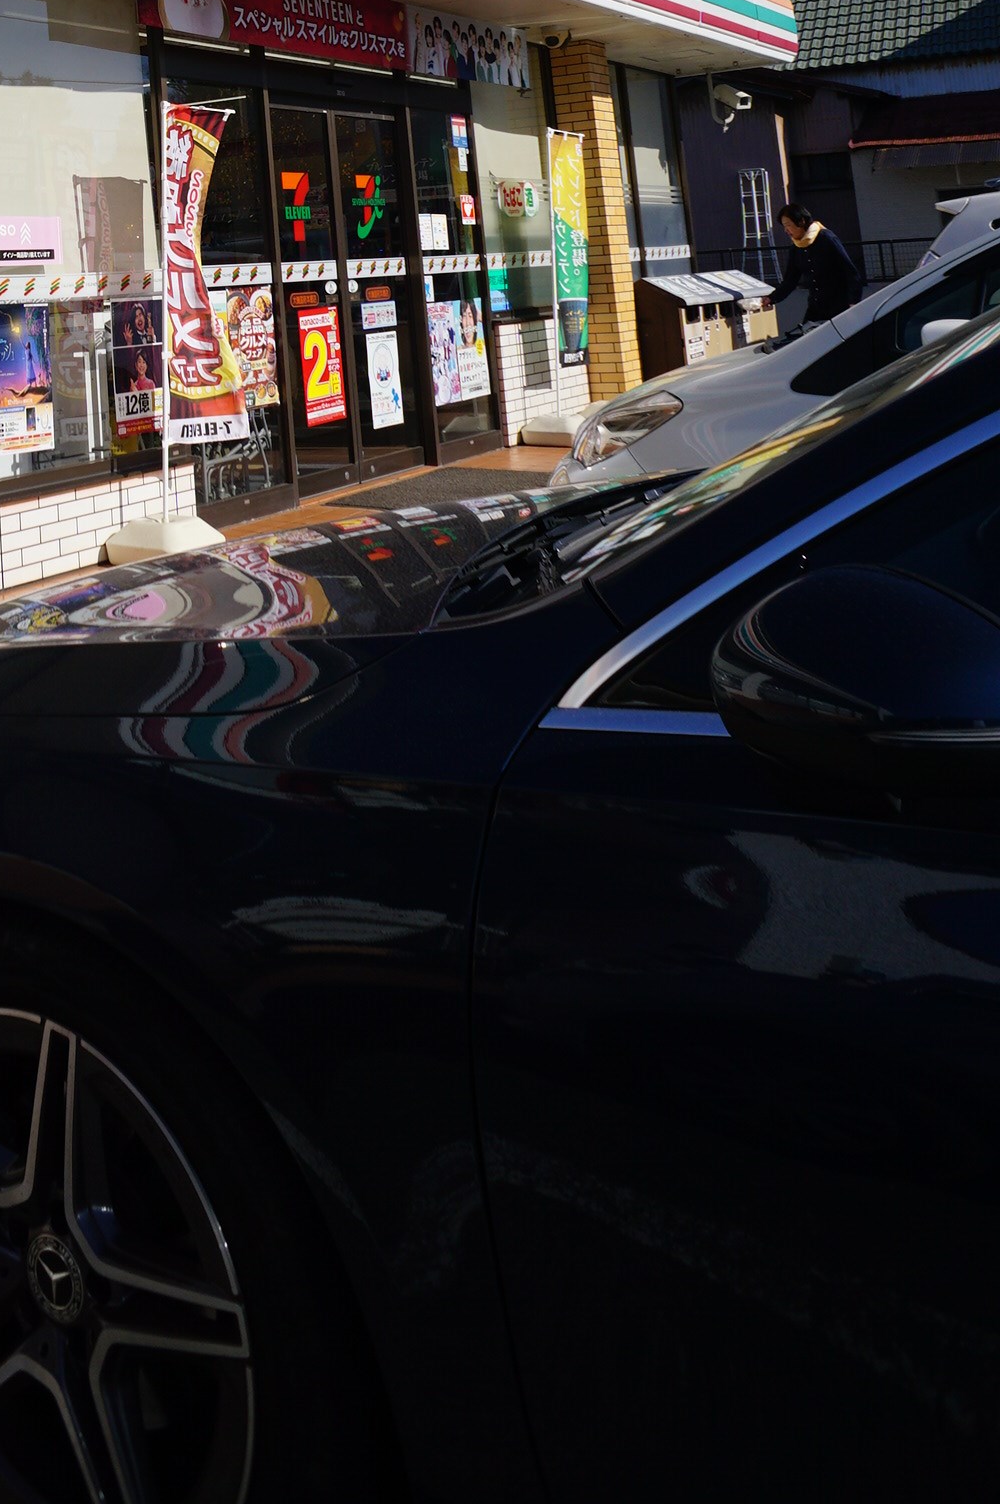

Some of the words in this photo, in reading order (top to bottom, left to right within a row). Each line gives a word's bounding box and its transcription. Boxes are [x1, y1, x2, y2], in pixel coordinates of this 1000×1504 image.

[233, 6, 406, 58] スペシャルスマイルなクリスマスを
[240, 317, 264, 335] 絶品
[240, 334, 267, 349] グルメ
[245, 348, 263, 360] フェア
